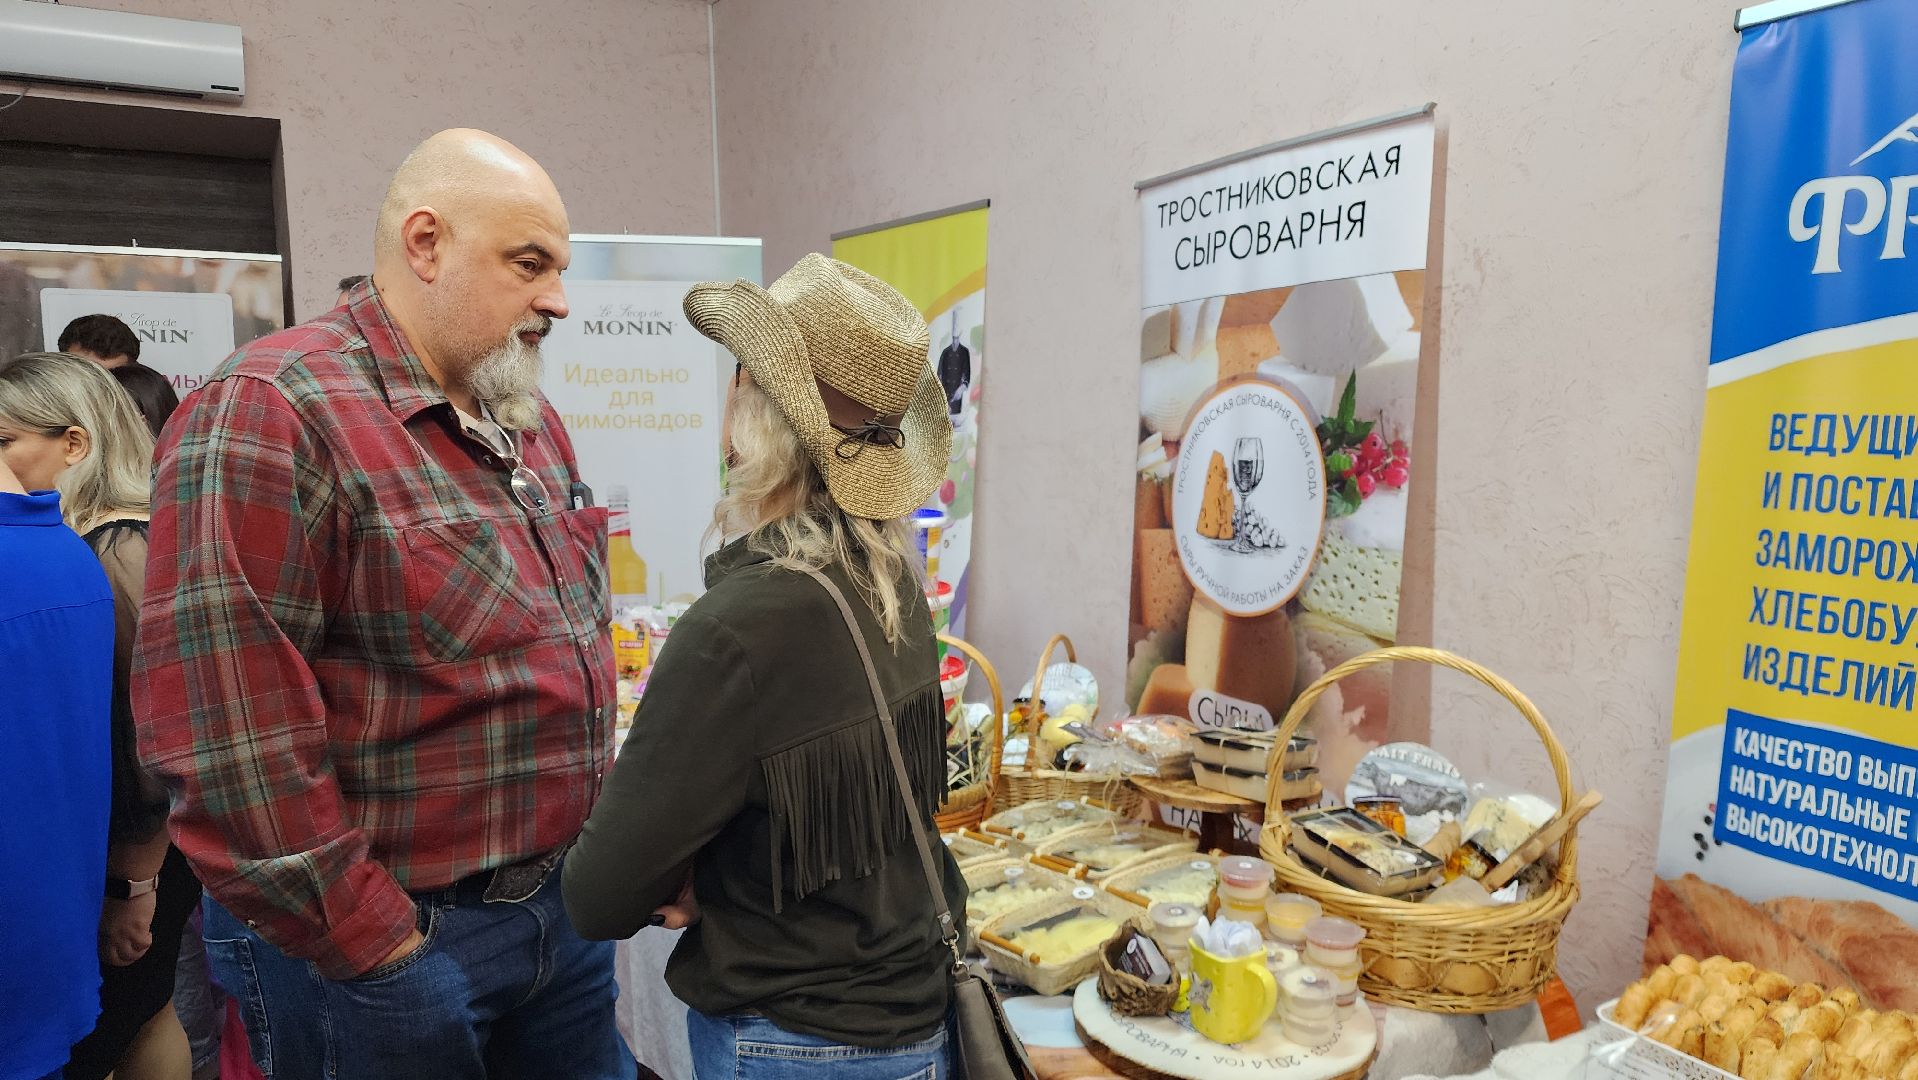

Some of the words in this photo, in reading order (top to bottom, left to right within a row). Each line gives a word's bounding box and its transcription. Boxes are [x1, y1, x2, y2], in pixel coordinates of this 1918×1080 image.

[1158, 144, 1402, 228] ТРОСТНИКОВСКАЯ
[1174, 200, 1367, 271] СЫРОВАРНЯ
[138, 328, 189, 344] NIN
[162, 317, 177, 327] de
[583, 320, 674, 336] MONIN
[564, 363, 690, 387] Идеально
[608, 391, 655, 409] для
[1235, 392, 1292, 422] СЫРОВАРНЯ
[1289, 418, 1299, 431] С
[1296, 427, 1312, 458] 2014
[1305, 459, 1317, 500] ГОДА
[1762, 471, 1783, 510] И
[1268, 581, 1284, 598] НА
[1748, 585, 1918, 650] ХЛЕБОБУ
[1742, 643, 1917, 713] ИЗДЕЛИЙ
[1733, 726, 1853, 781] КАЧЕСТВО
[1857, 754, 1918, 799] ВЫП
[1729, 764, 1911, 841] НАТУРАЛЬНЫЕ
